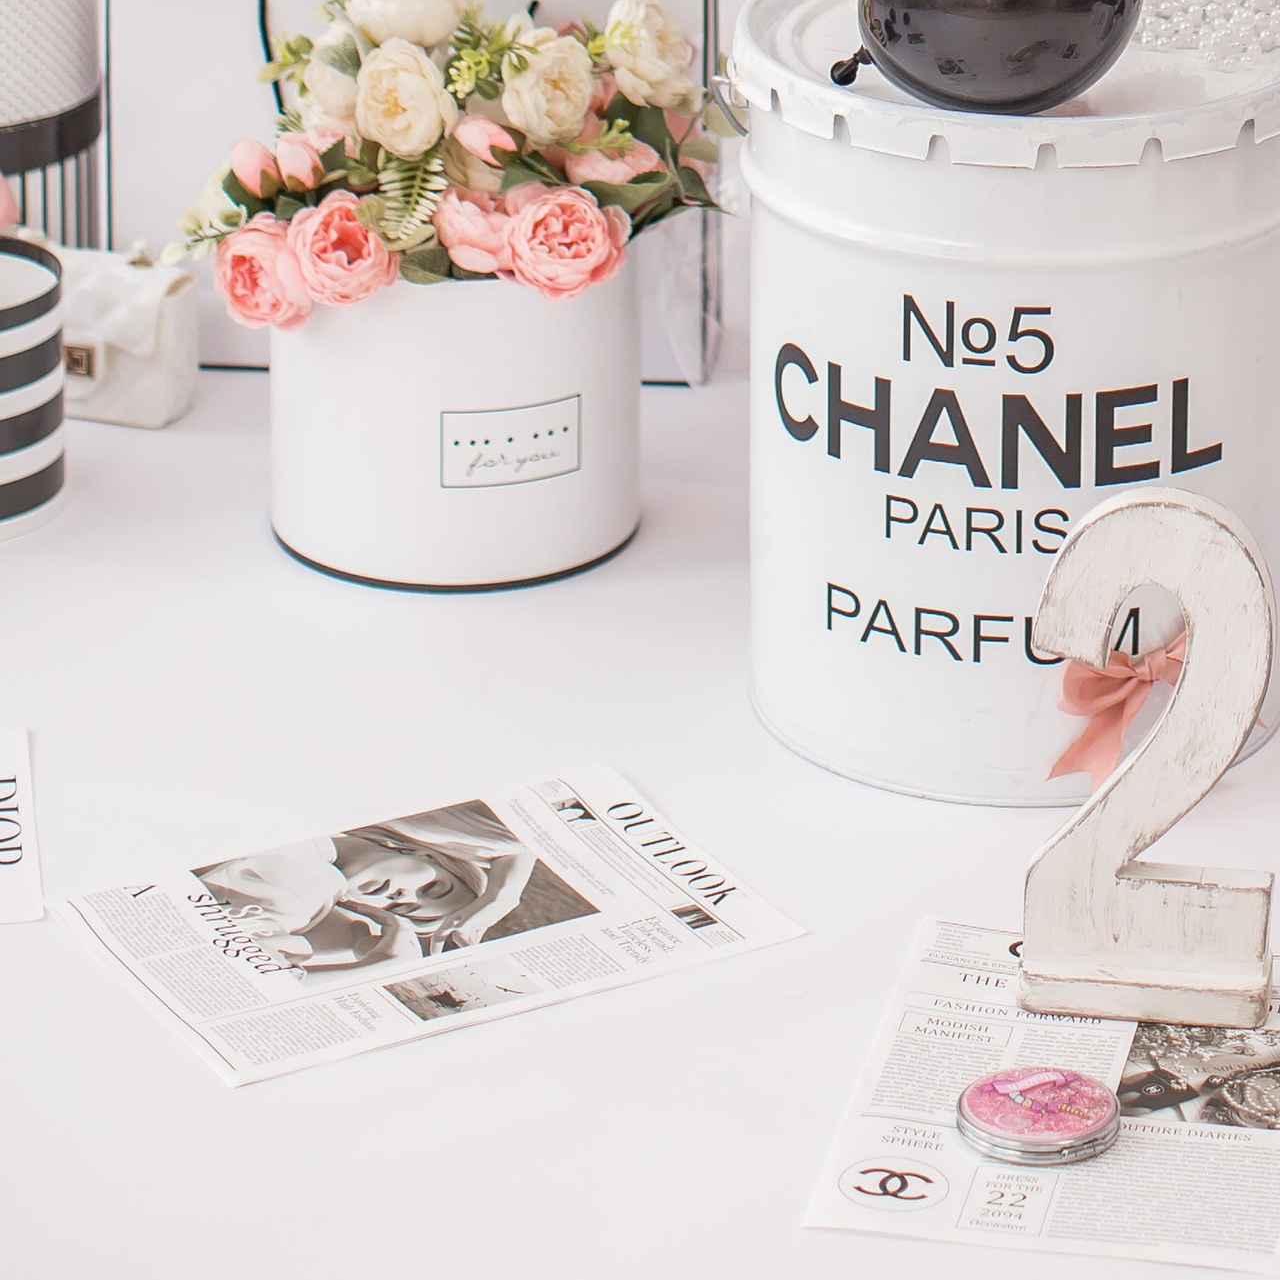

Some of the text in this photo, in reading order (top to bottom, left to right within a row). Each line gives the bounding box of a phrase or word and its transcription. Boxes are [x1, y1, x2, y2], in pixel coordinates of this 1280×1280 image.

[774, 343, 1223, 489] CHANEL
[885, 495, 1070, 554] PARIS
[606, 802, 747, 906] OUTLOOK
[187, 893, 293, 975] shrugged
[959, 972, 1008, 988] THE
[933, 999, 1102, 1025] FASHION FORWARD
[927, 1017, 989, 1033] MODISH
[914, 1026, 996, 1044] MANIFEST
[892, 1125, 943, 1140] STYLE
[1187, 1129, 1253, 1142] DIARIES
[880, 1135, 945, 1152] SPHERE
[986, 1191, 1028, 1208] 22
